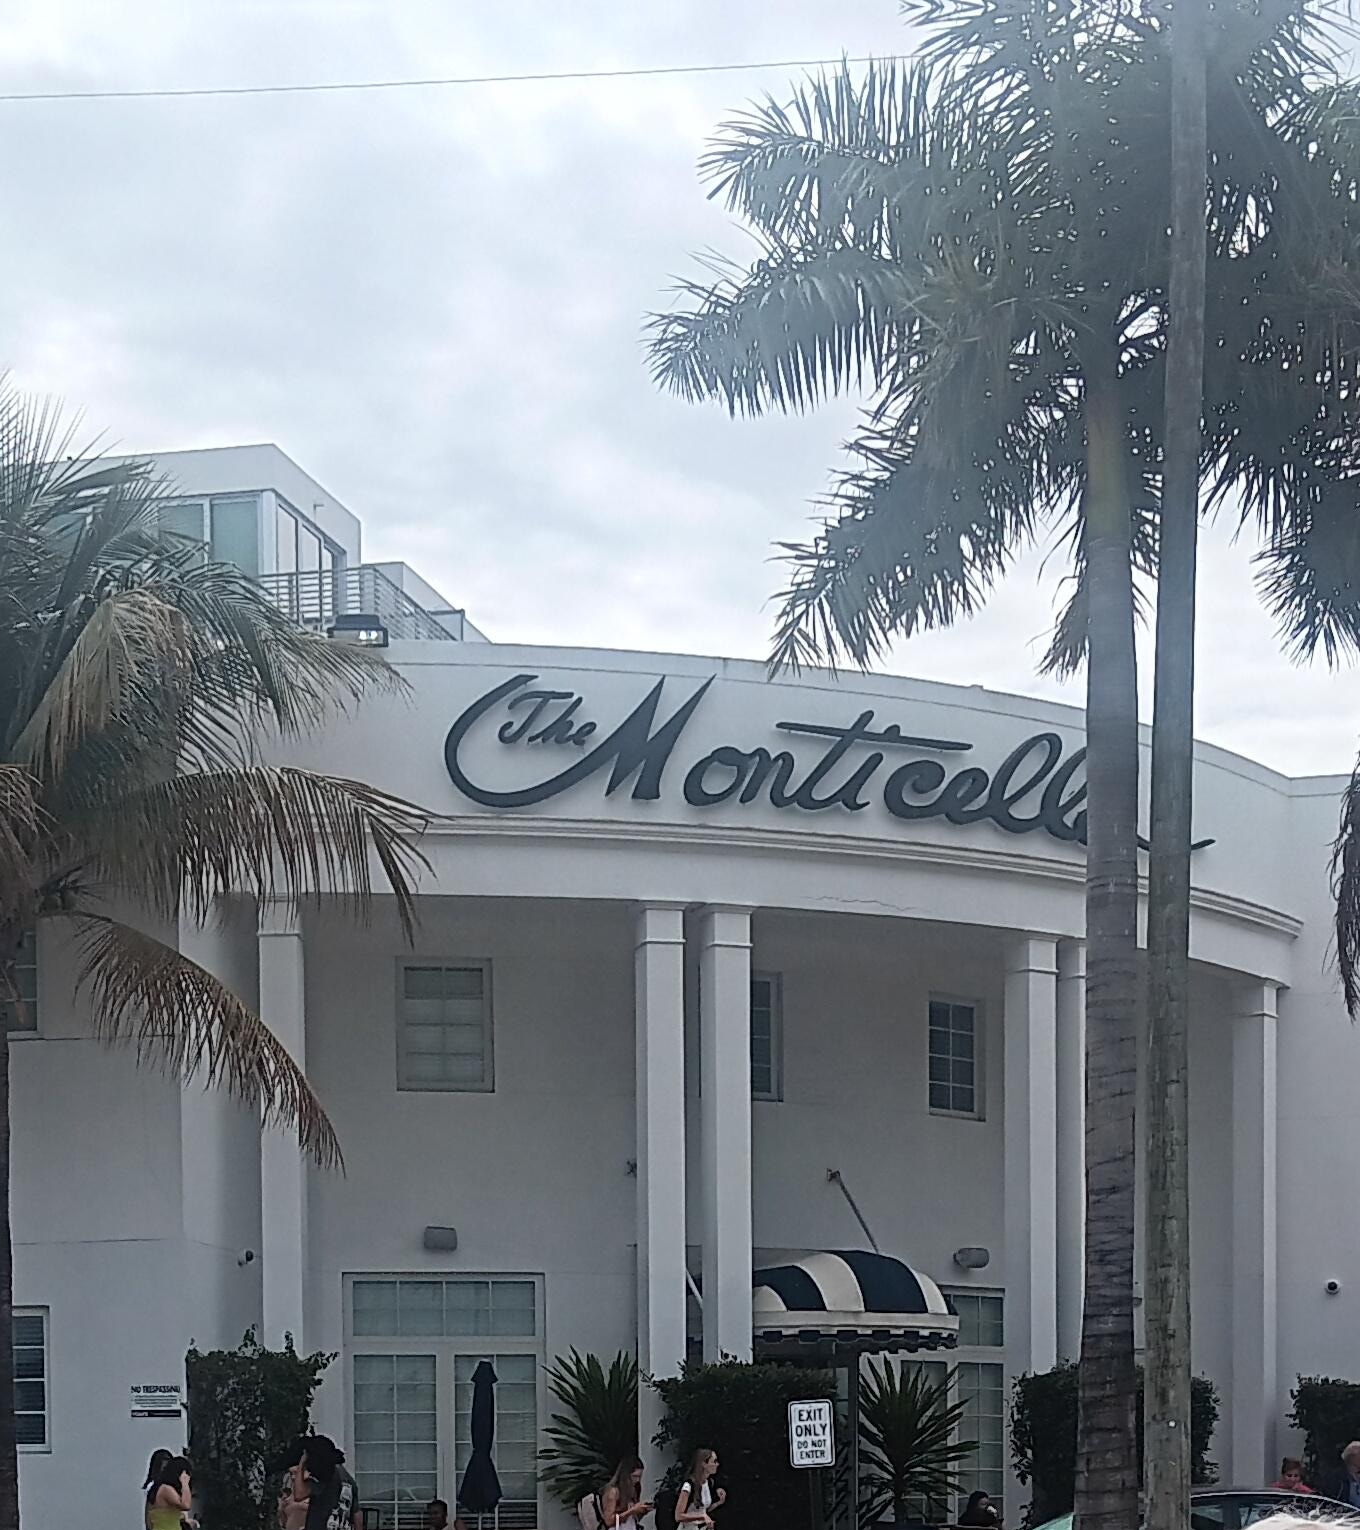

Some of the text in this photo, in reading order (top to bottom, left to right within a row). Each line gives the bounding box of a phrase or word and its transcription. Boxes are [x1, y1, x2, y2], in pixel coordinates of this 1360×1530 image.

[444, 674, 1215, 852] The Monticell
[798, 1408, 823, 1422] EXIT
[795, 1423, 827, 1438] ONLY
[797, 1439, 827, 1449] DO NOT
[800, 1450, 826, 1460] ENTER
